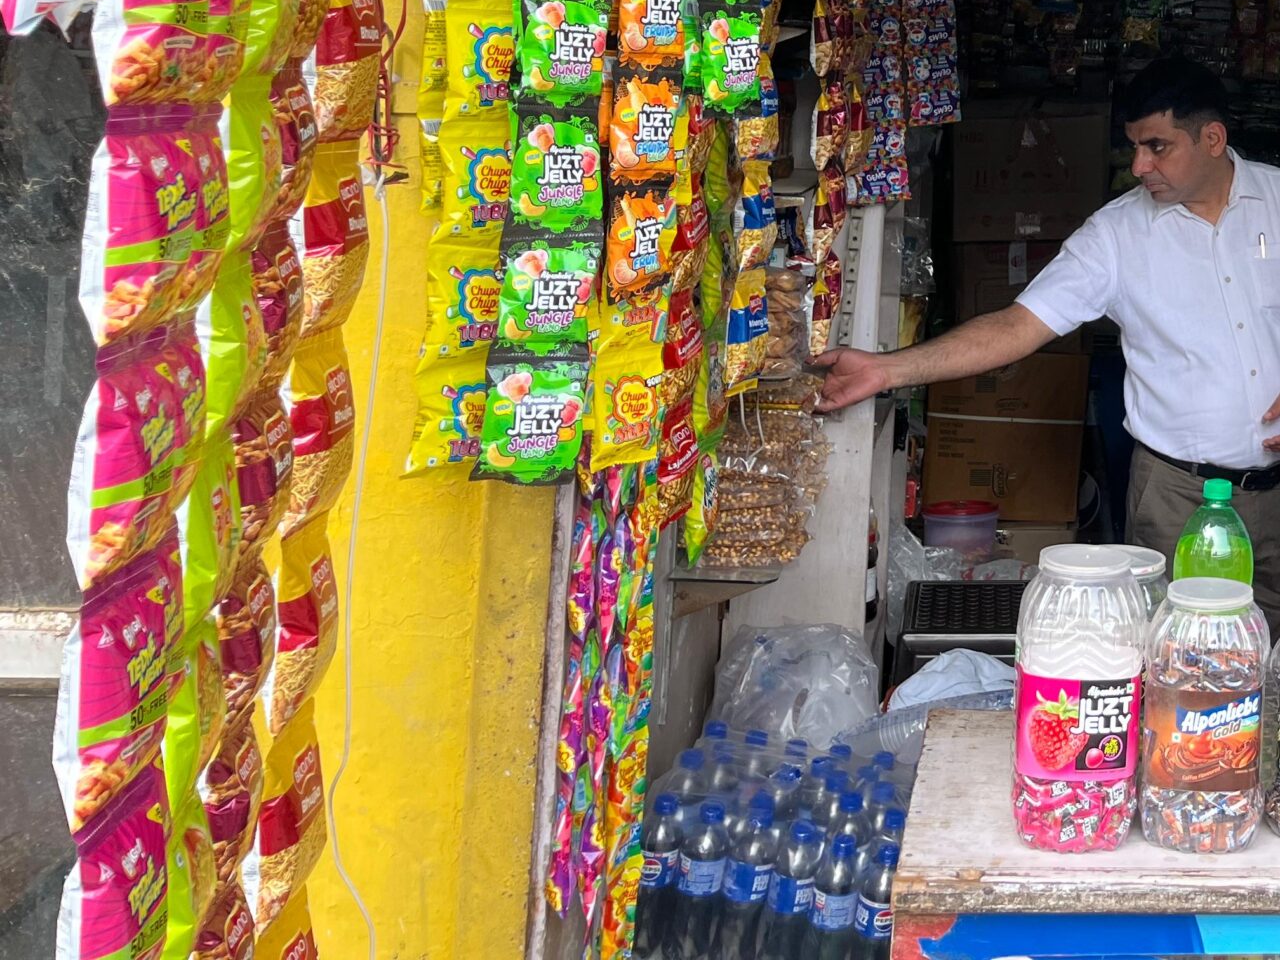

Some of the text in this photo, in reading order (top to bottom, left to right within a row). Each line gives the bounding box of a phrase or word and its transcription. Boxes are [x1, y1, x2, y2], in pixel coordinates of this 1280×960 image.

[641, 8, 679, 24] JELLY
[554, 30, 596, 49] JUZT
[550, 44, 595, 61] JELLY
[723, 56, 759, 72] JELLY
[638, 112, 673, 128] JUZT
[634, 125, 673, 141] JELLY
[544, 153, 583, 170] JUZT
[537, 167, 584, 185] JELLY
[533, 280, 579, 296] JUZT
[526, 294, 578, 310] JELLY
[621, 392, 649, 403] Chupa
[515, 403, 564, 420] JUZT
[621, 402, 649, 417] Chups
[507, 418, 563, 436] JELLY
[1079, 696, 1133, 716] JUZT
[1181, 695, 1261, 735] Alpenliebe
[1070, 714, 1132, 734] JELLY
[1212, 719, 1242, 740] Gold
